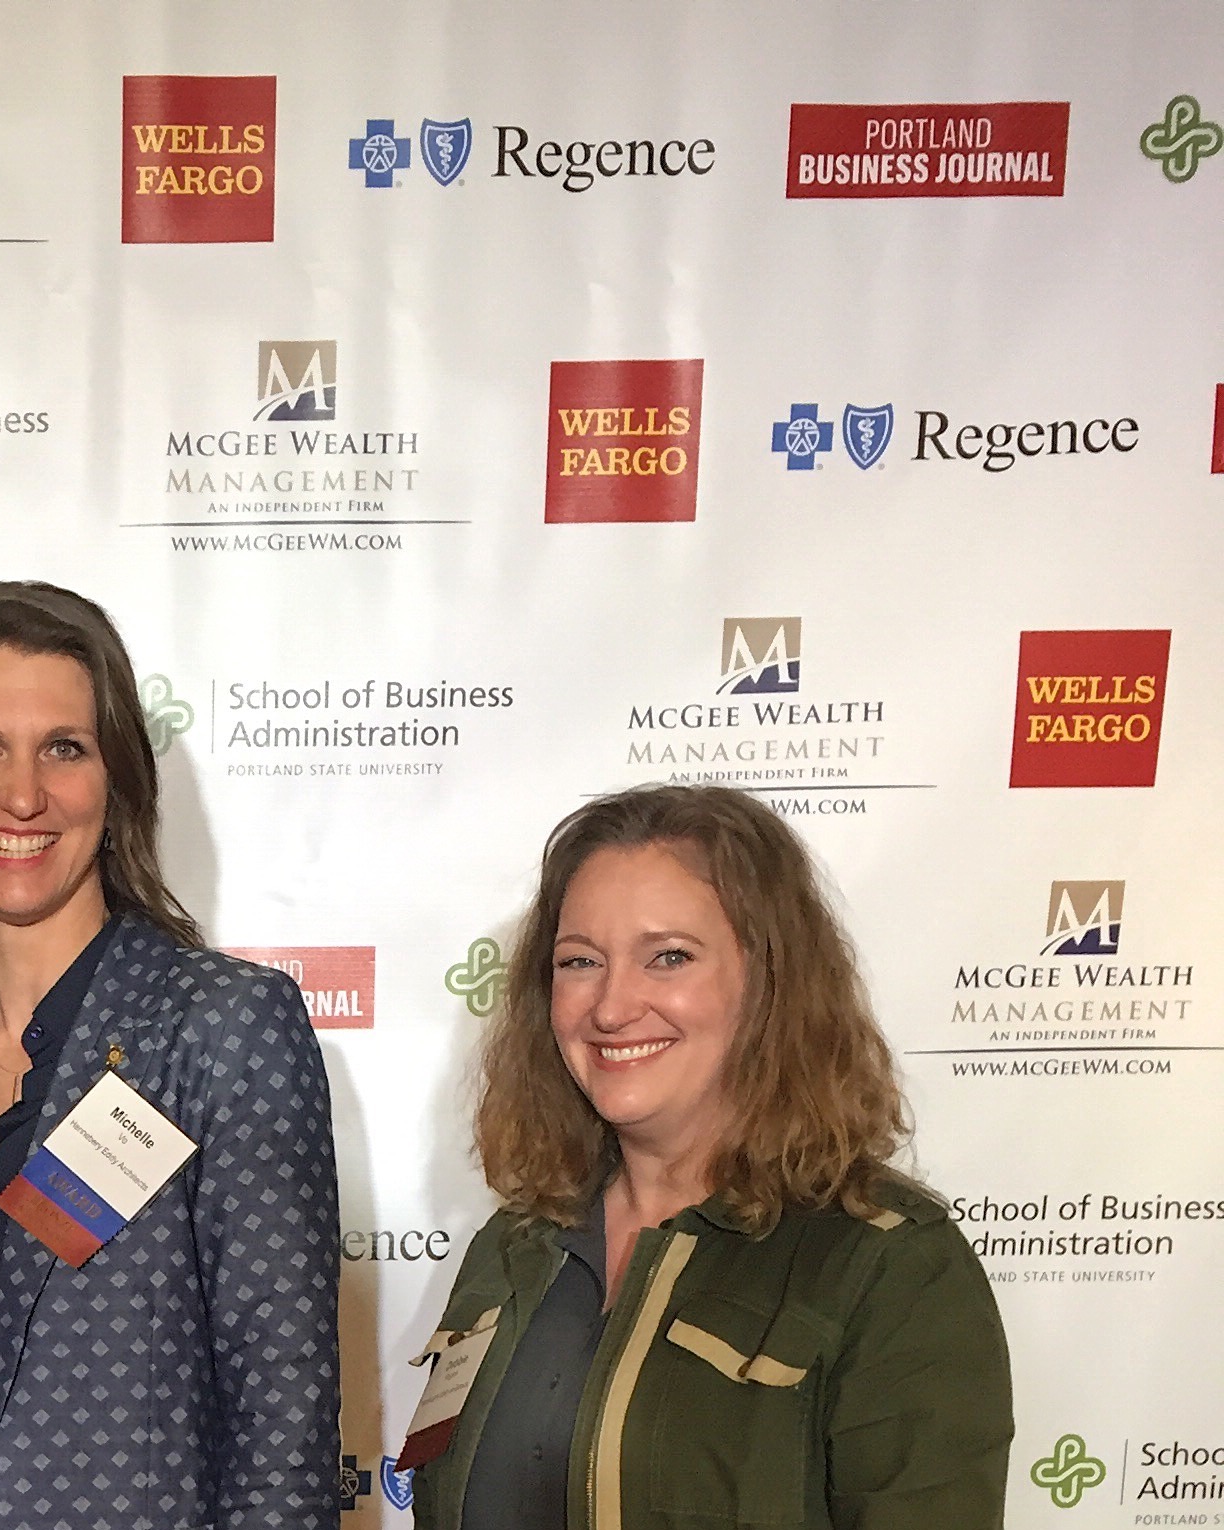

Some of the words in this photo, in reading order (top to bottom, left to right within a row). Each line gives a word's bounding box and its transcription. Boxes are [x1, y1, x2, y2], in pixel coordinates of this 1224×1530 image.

[132, 125, 264, 154] WELLS
[866, 118, 991, 149] PORTLAND
[493, 126, 715, 192] Regence
[799, 153, 928, 184] BUSINESS
[935, 152, 1053, 183] JOURNAL
[136, 166, 263, 195] FARGO
[558, 407, 690, 437] WELLS
[290, 431, 417, 455] WEALTH
[911, 411, 1139, 472] Regence
[560, 445, 687, 476] FARGO
[166, 469, 418, 494] MANAGEMENT
[207, 503, 228, 513] AN
[236, 502, 342, 512] INDEPENDENT
[349, 500, 383, 511] FIRM
[230, 681, 329, 709] School
[342, 680, 375, 708] of
[386, 680, 513, 708] Business
[1026, 676, 1155, 703] WELLS
[754, 702, 883, 725] WEALTH
[228, 719, 458, 747] Administration
[1026, 714, 1150, 742] FARGO
[627, 737, 884, 764] MANAGEMENT
[228, 764, 303, 776] PORTLAND
[310, 764, 351, 776] STATE
[360, 763, 443, 775] UNIVERSITY
[669, 772, 689, 784] AN
[696, 770, 807, 781] INDEPENDENT
[812, 767, 847, 777] FIRM
[1075, 964, 1192, 987] WEALTH
[305, 991, 363, 1017] RNAL
[951, 1000, 1189, 1022] MANAGEMENT
[990, 1031, 1010, 1040] AN
[1016, 1030, 1116, 1040] INDEPENDENT
[1122, 1028, 1155, 1039] FIRM
[110, 1106, 155, 1150] Michelle
[950, 1196, 1048, 1222] School
[1059, 1194, 1091, 1220] of
[1102, 1195, 1224, 1220] Business
[342, 1230, 450, 1261] ence
[972, 1231, 1173, 1256] dministration
[1024, 1271, 1064, 1282] STATE
[1072, 1271, 1155, 1282] UNIVERSITY
[1141, 1442, 1224, 1466] Schoo
[1135, 1514, 1208, 1525] PORTLAND
